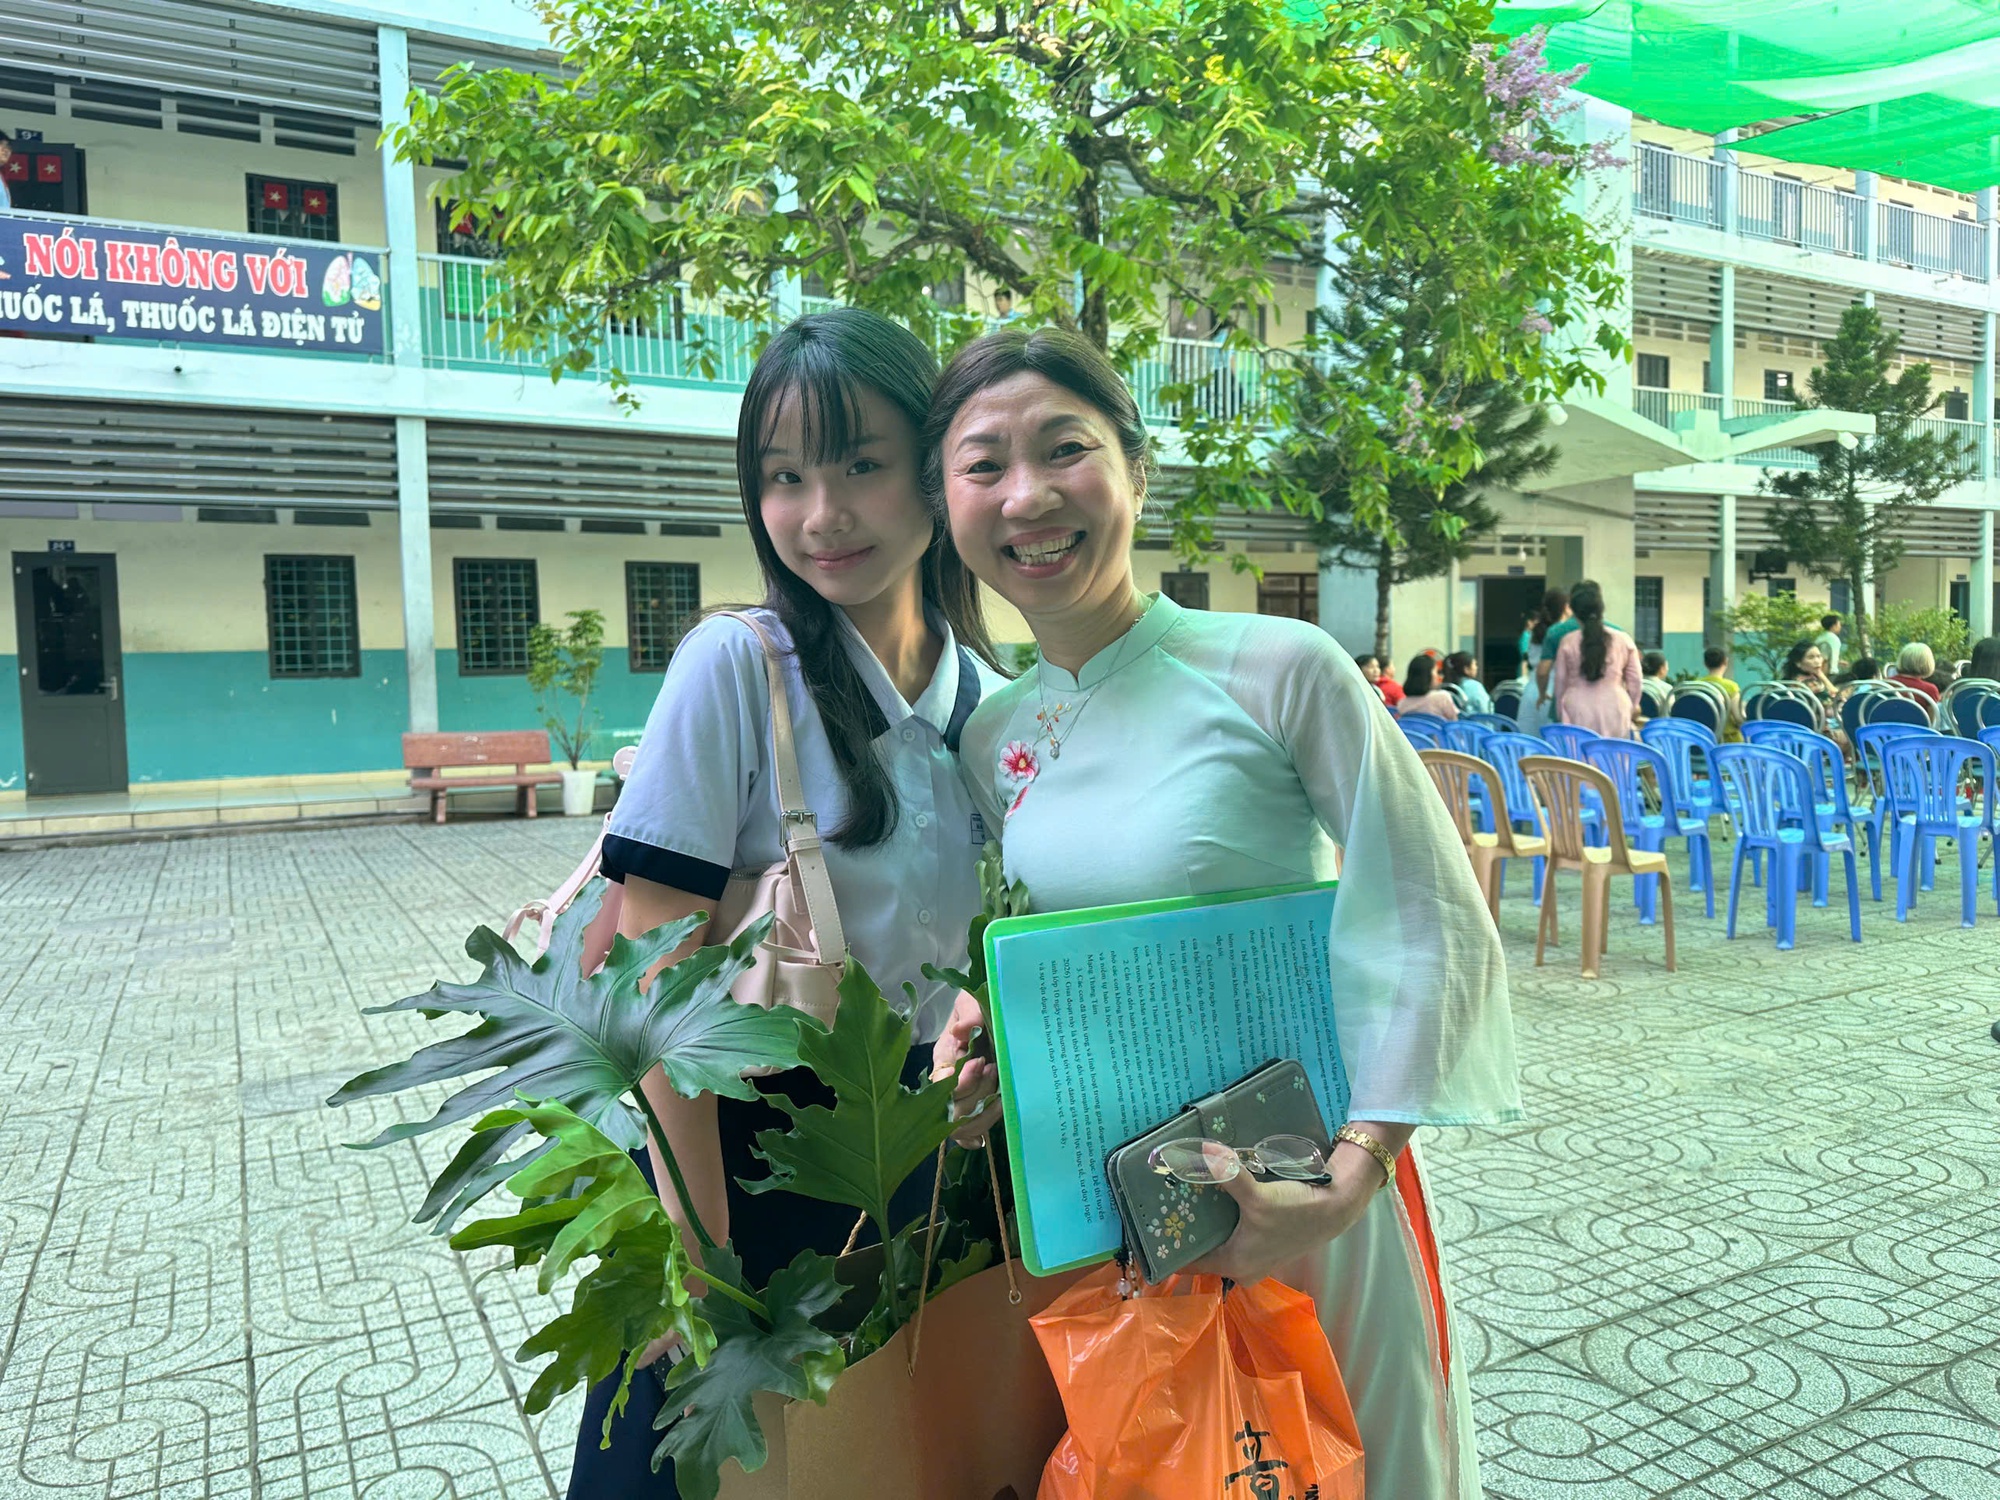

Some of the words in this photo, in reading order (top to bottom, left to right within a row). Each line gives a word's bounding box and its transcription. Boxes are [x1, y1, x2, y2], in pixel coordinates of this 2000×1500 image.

[23, 227, 99, 280] NÓI
[104, 237, 238, 292] KHÔNG
[243, 247, 308, 298] VỚI
[0, 283, 63, 322] UỐC
[69, 291, 116, 333] LÁ,
[121, 295, 216, 334] THUỐC
[221, 303, 257, 336] LÁ
[261, 307, 326, 346] ĐIỆN
[331, 311, 365, 344] TỬ
[1053, 988, 1060, 998] 10
[1194, 964, 1203, 985] THCS
